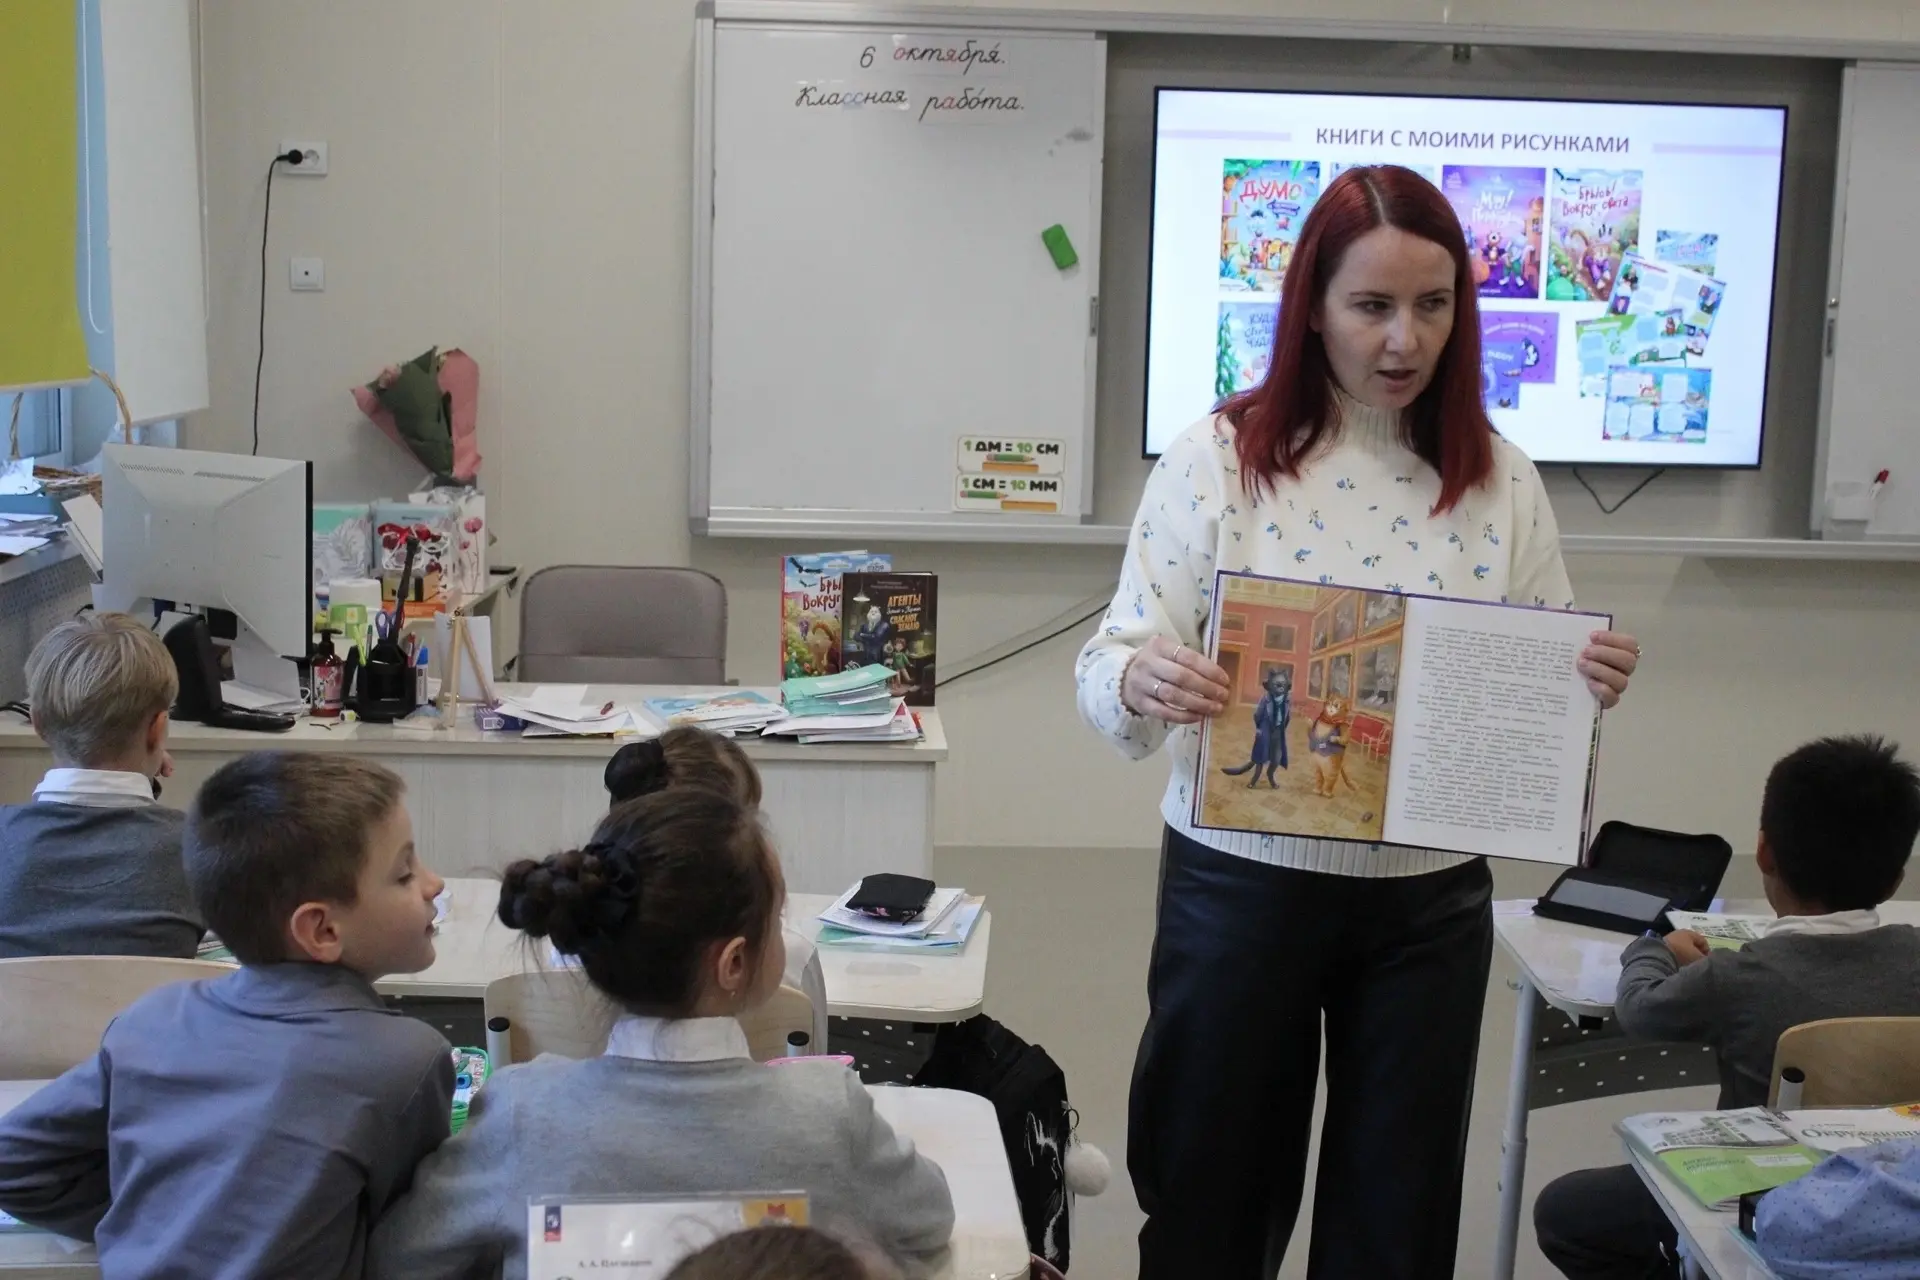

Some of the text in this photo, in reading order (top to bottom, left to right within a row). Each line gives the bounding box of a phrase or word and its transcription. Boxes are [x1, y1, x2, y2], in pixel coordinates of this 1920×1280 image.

[860, 46, 876, 68] 6
[795, 85, 908, 107] Классная
[1316, 128, 1630, 153] КНИГИ С МОИМИ РИСУНКАМИ
[964, 440, 972, 451] 1
[1005, 443, 1012, 451] =
[1016, 442, 1033, 453] 10
[1036, 443, 1059, 455] СМ
[962, 478, 1057, 492] 1 СМ = 10 ММ
